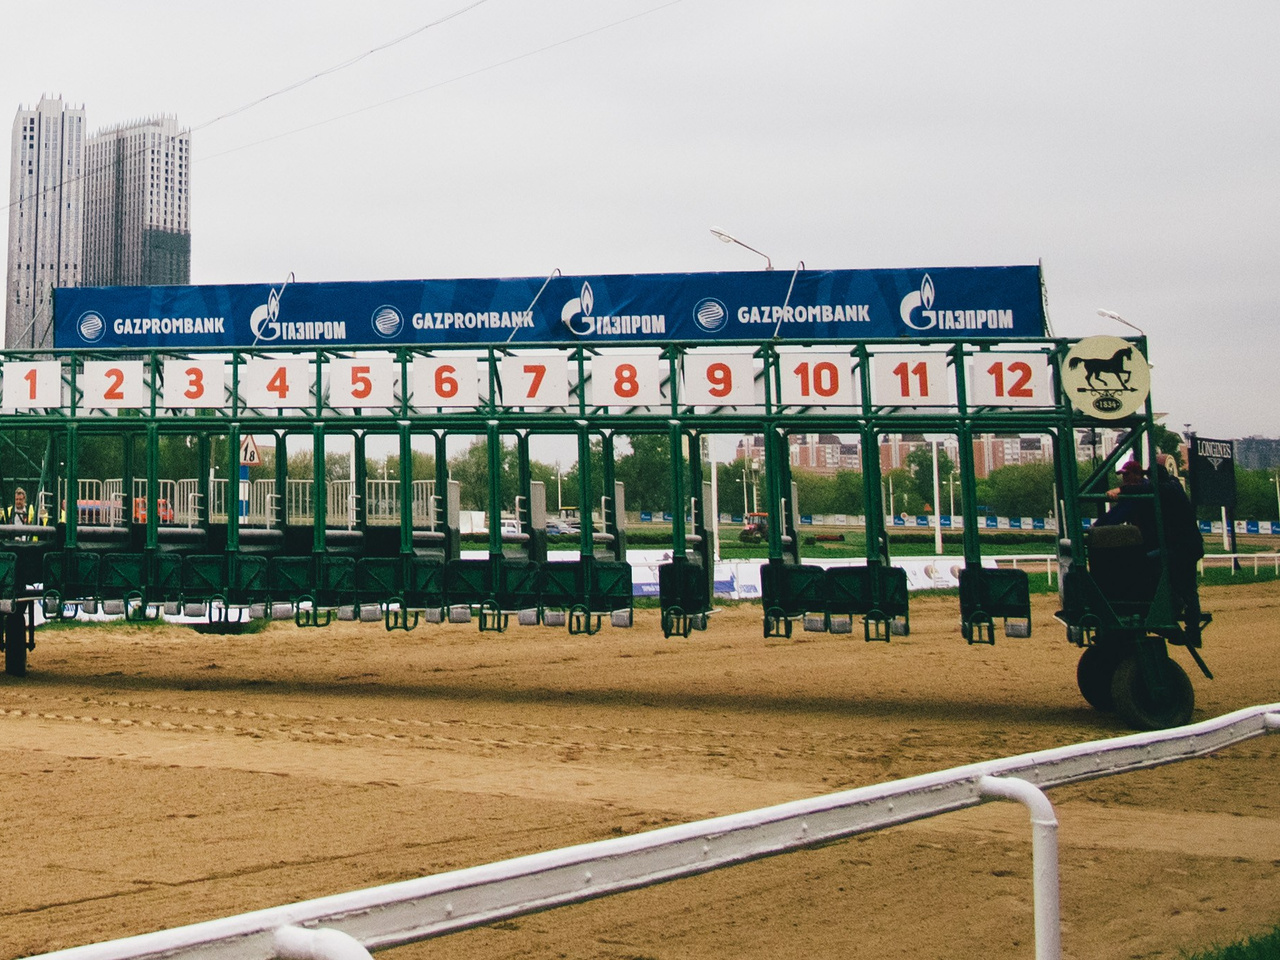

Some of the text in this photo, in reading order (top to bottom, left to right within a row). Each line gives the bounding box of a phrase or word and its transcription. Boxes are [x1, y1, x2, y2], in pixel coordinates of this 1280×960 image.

[113, 317, 225, 335] GAZPROMBANK
[412, 311, 535, 330] GAZPROMBANK
[596, 315, 666, 334] ГАЗПРОМ
[737, 305, 871, 323] GAZPROMBANK
[938, 309, 1013, 330] ГАЗПРОМ
[282, 321, 346, 339] ГАЗПРОМ
[24, 369, 37, 399] 1
[103, 368, 124, 399] 2
[183, 367, 204, 399] 3
[266, 367, 289, 398] 4
[351, 366, 372, 399] 5
[434, 365, 458, 398] 6
[523, 365, 546, 398] 7
[613, 363, 639, 398] 8
[706, 363, 732, 397] 9
[793, 362, 839, 397] 10
[893, 362, 929, 397] 11
[987, 362, 1033, 397] 12
[1099, 400, 1117, 409] 1834
[1197, 440, 1231, 458] LONGINES
